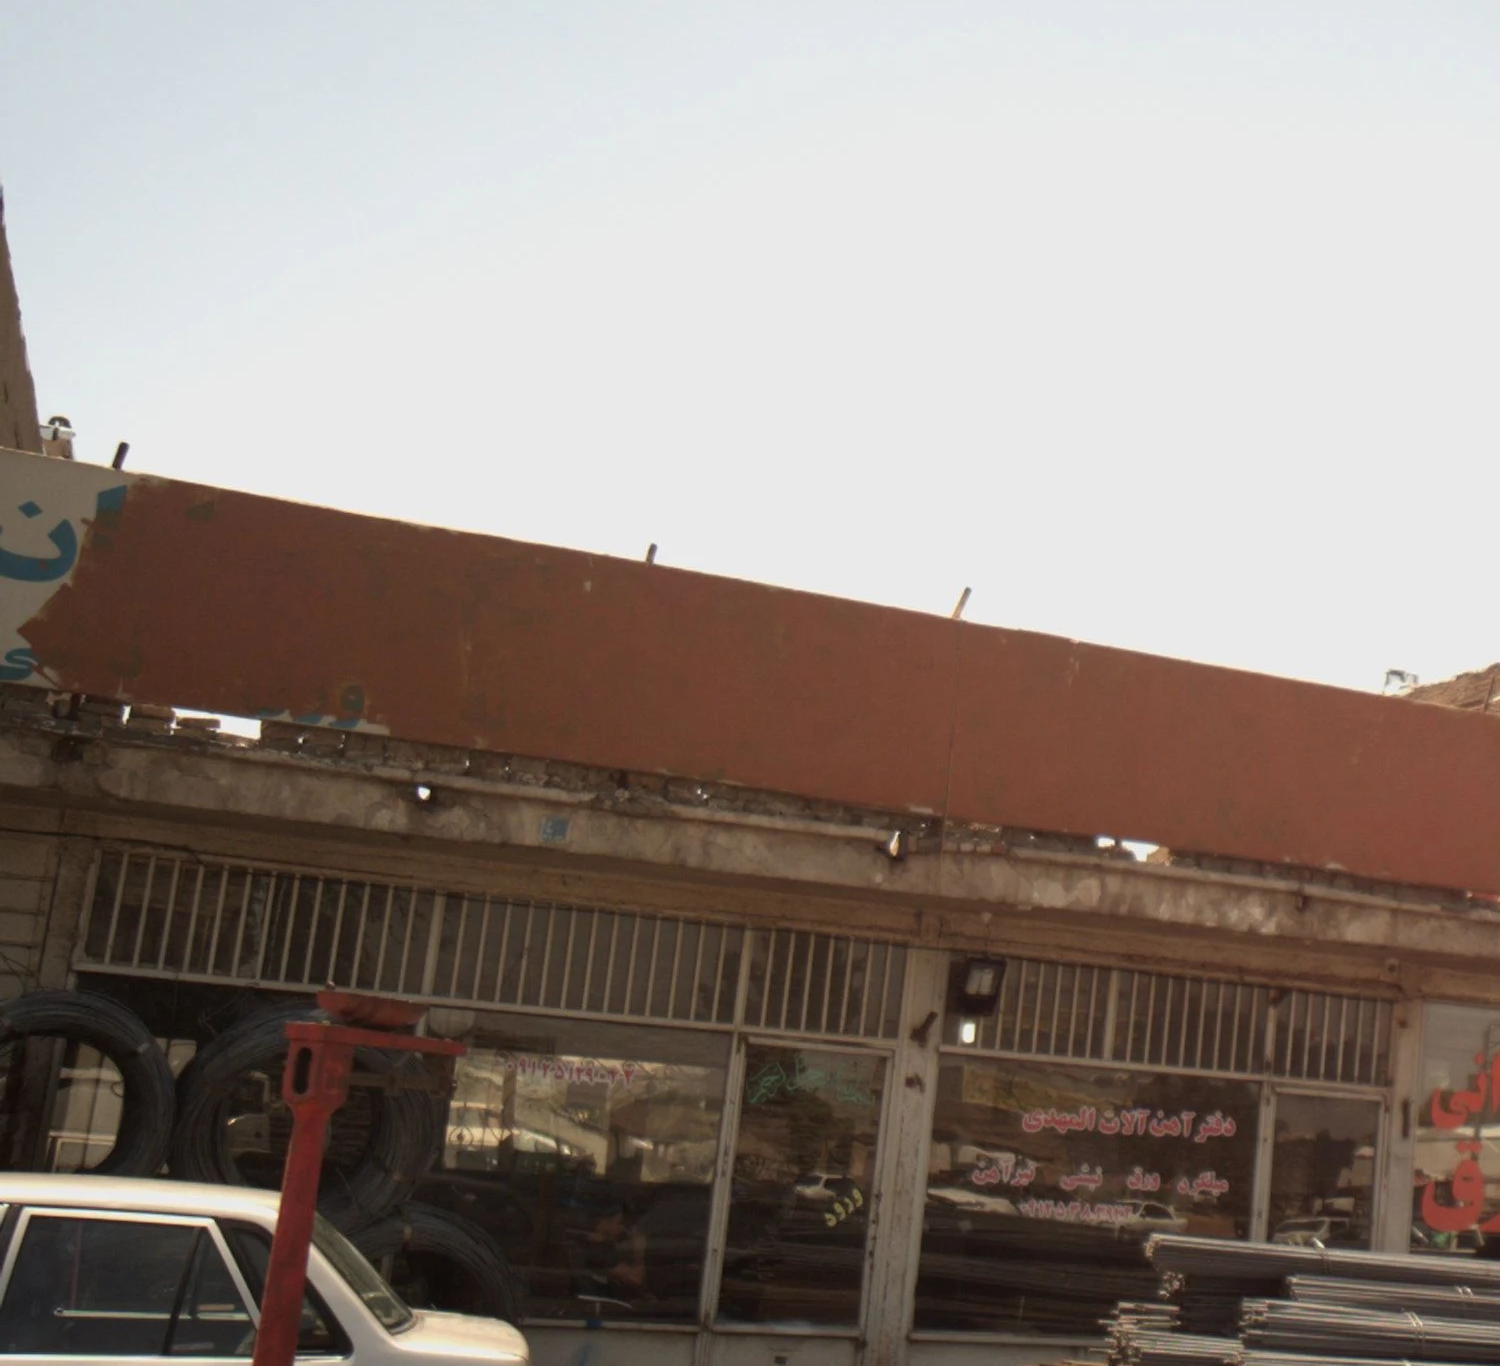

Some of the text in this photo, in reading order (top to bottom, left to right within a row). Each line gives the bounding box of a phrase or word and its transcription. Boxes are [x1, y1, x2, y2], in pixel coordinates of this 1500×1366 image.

[1021, 1105, 1097, 1134] المهدی
[1148, 1108, 1197, 1139] آهن
[1193, 1110, 1237, 1144] دفتر
[1059, 1163, 1104, 1192] نبشی
[1126, 1166, 1161, 1192] ورق
[1176, 1170, 1230, 1197] میلگرد
[823, 1187, 864, 1228] ورود
